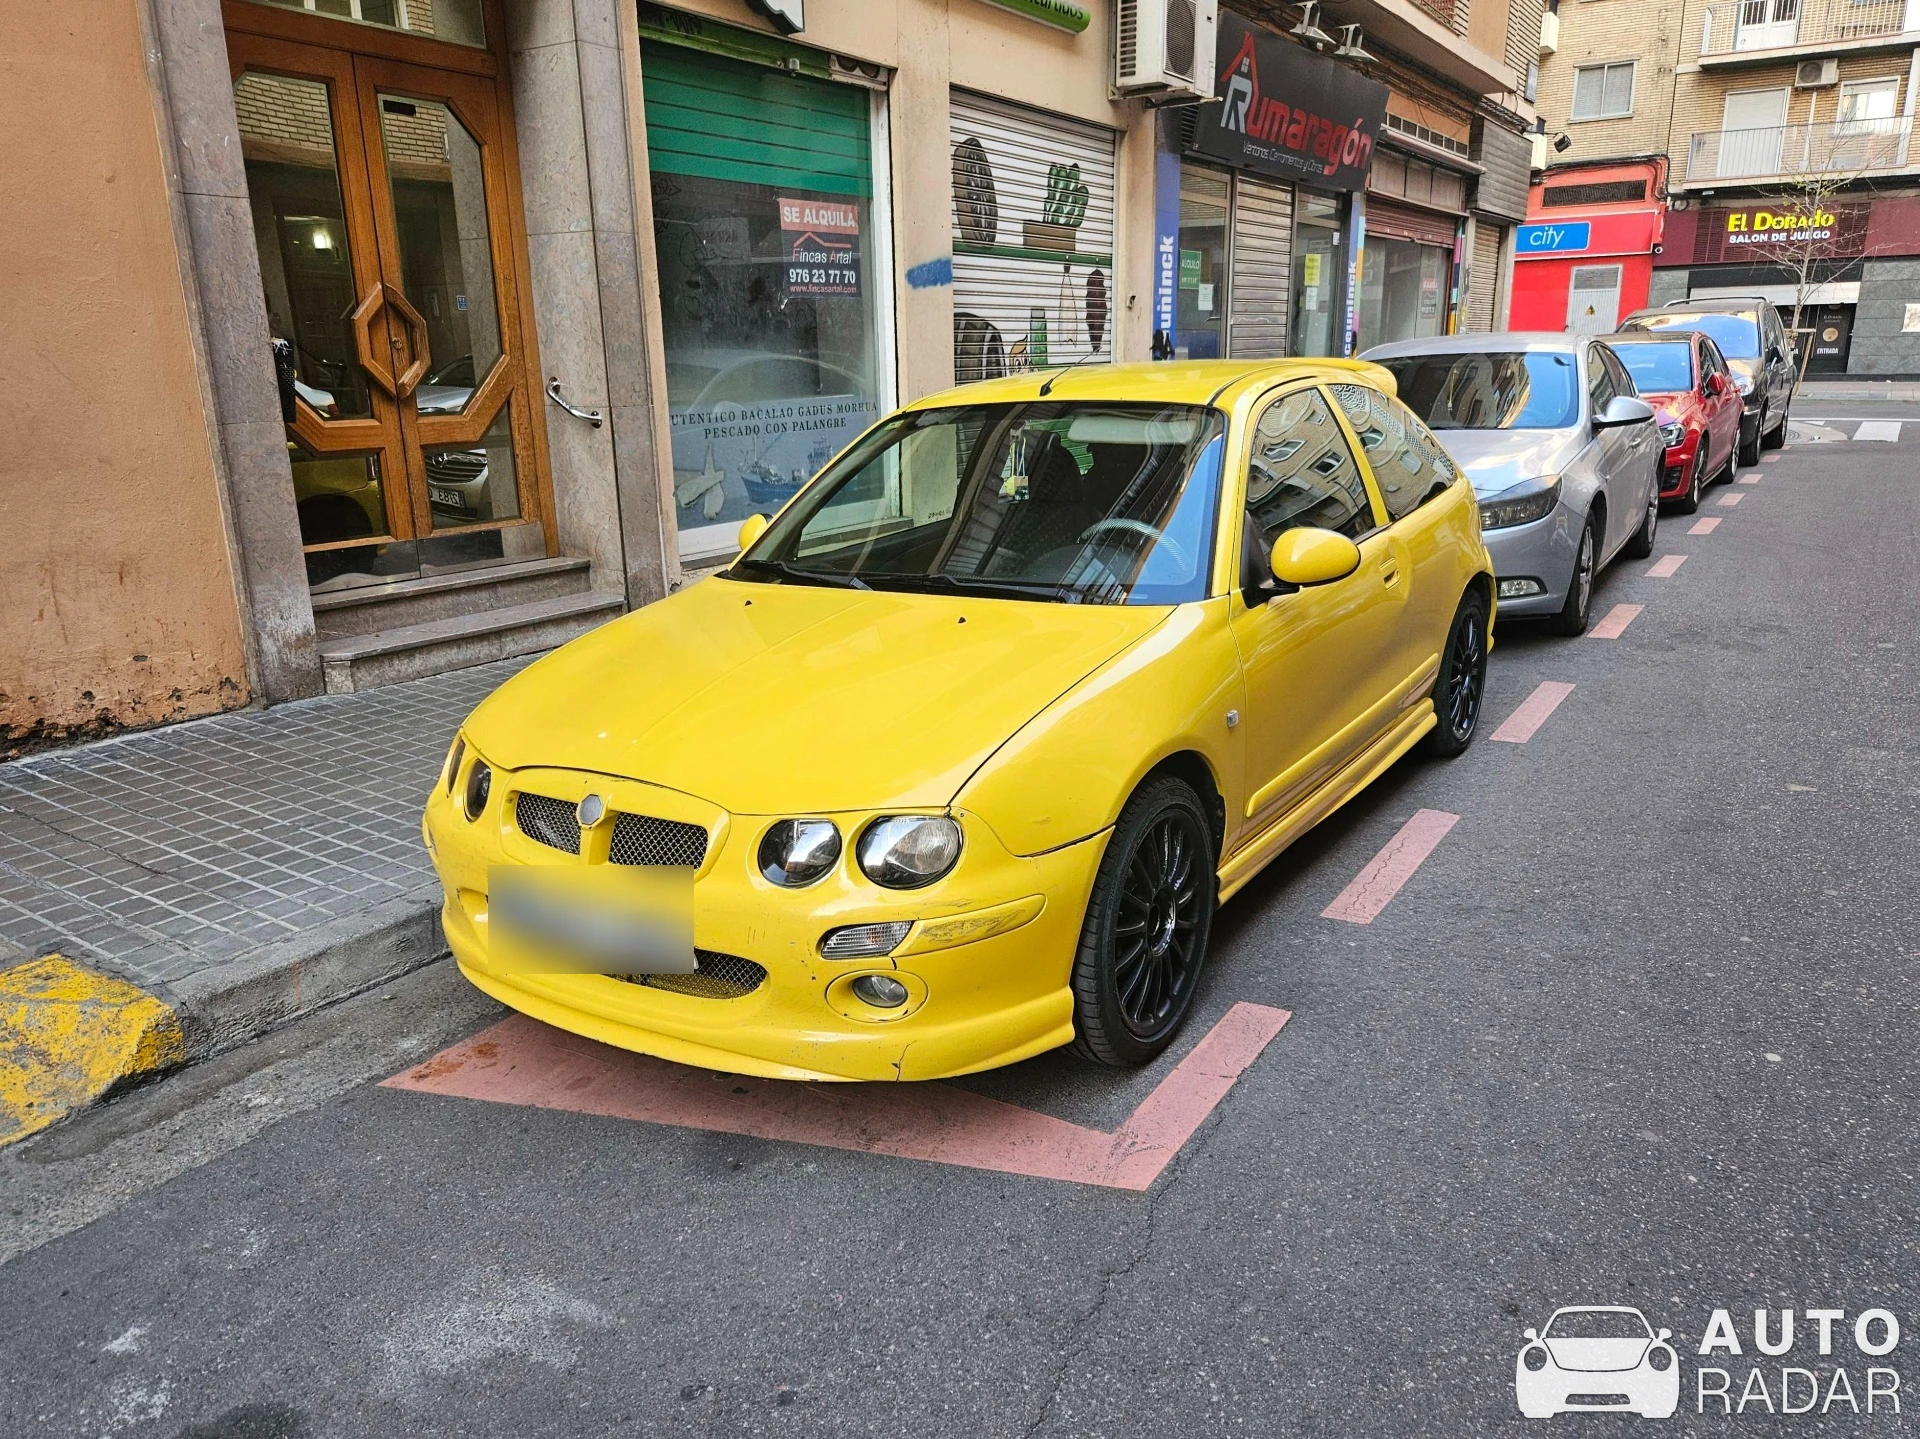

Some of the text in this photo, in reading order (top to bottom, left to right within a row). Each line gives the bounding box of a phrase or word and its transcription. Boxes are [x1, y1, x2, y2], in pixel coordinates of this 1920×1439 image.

[1220, 74, 1372, 176] Rumaragón
[783, 206, 856, 228] SE ALQUILA
[1529, 226, 1565, 249] city
[1729, 232, 1769, 244] SALON
[1771, 232, 1788, 242] DE
[792, 248, 852, 265] Fincas Artal
[789, 268, 856, 284] 976 23 77 70
[789, 283, 857, 294] www.fincasartal.com
[1344, 260, 1357, 359] ceuninck
[671, 401, 878, 426] UTENTICO BACALAO GADUS MORHUA
[704, 417, 847, 440] PESCADO CON PALANGRE
